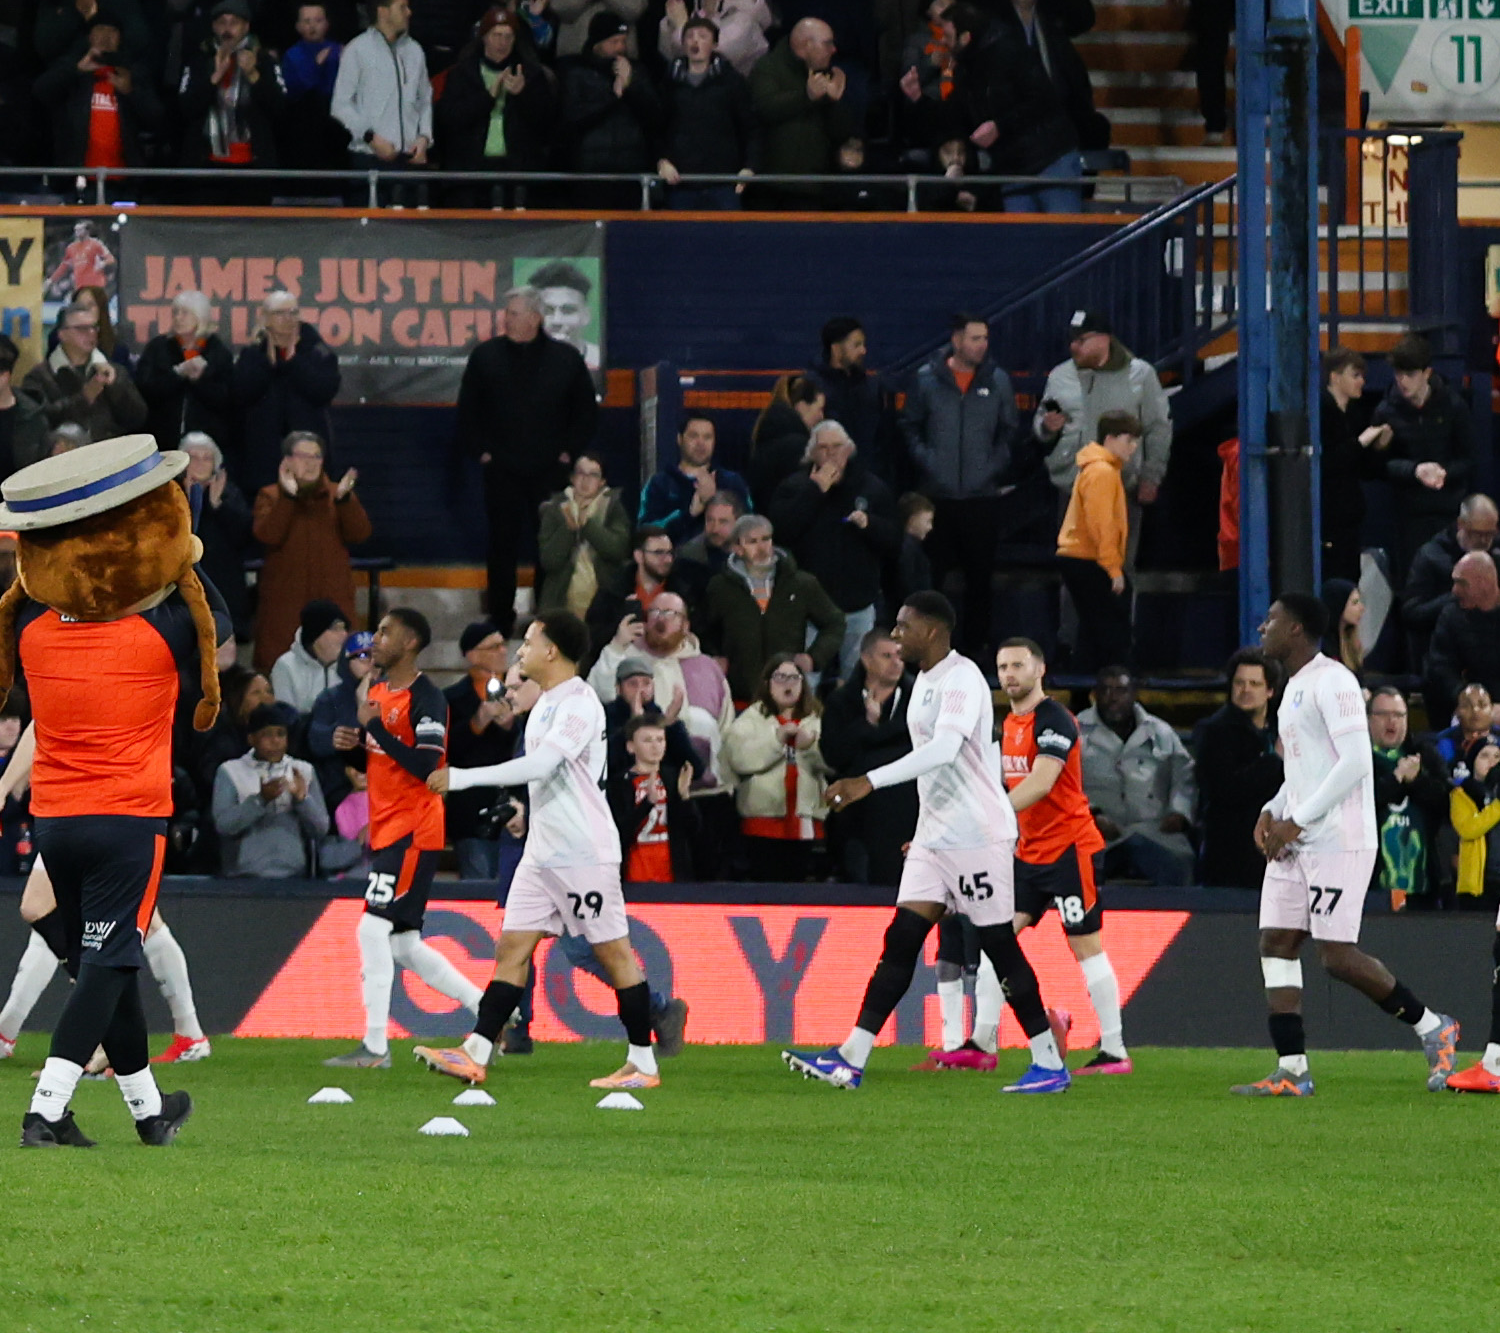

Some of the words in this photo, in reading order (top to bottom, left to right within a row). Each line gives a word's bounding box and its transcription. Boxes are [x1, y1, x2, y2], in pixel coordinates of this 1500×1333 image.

[1450, 35, 1483, 84] 11
[139, 256, 303, 301] JAMES
[314, 258, 497, 304] JUSTIN
[366, 872, 396, 903] 25
[959, 871, 994, 901] 45
[1309, 886, 1343, 916] 27
[567, 890, 603, 920] 29
[1054, 895, 1085, 925] 18
